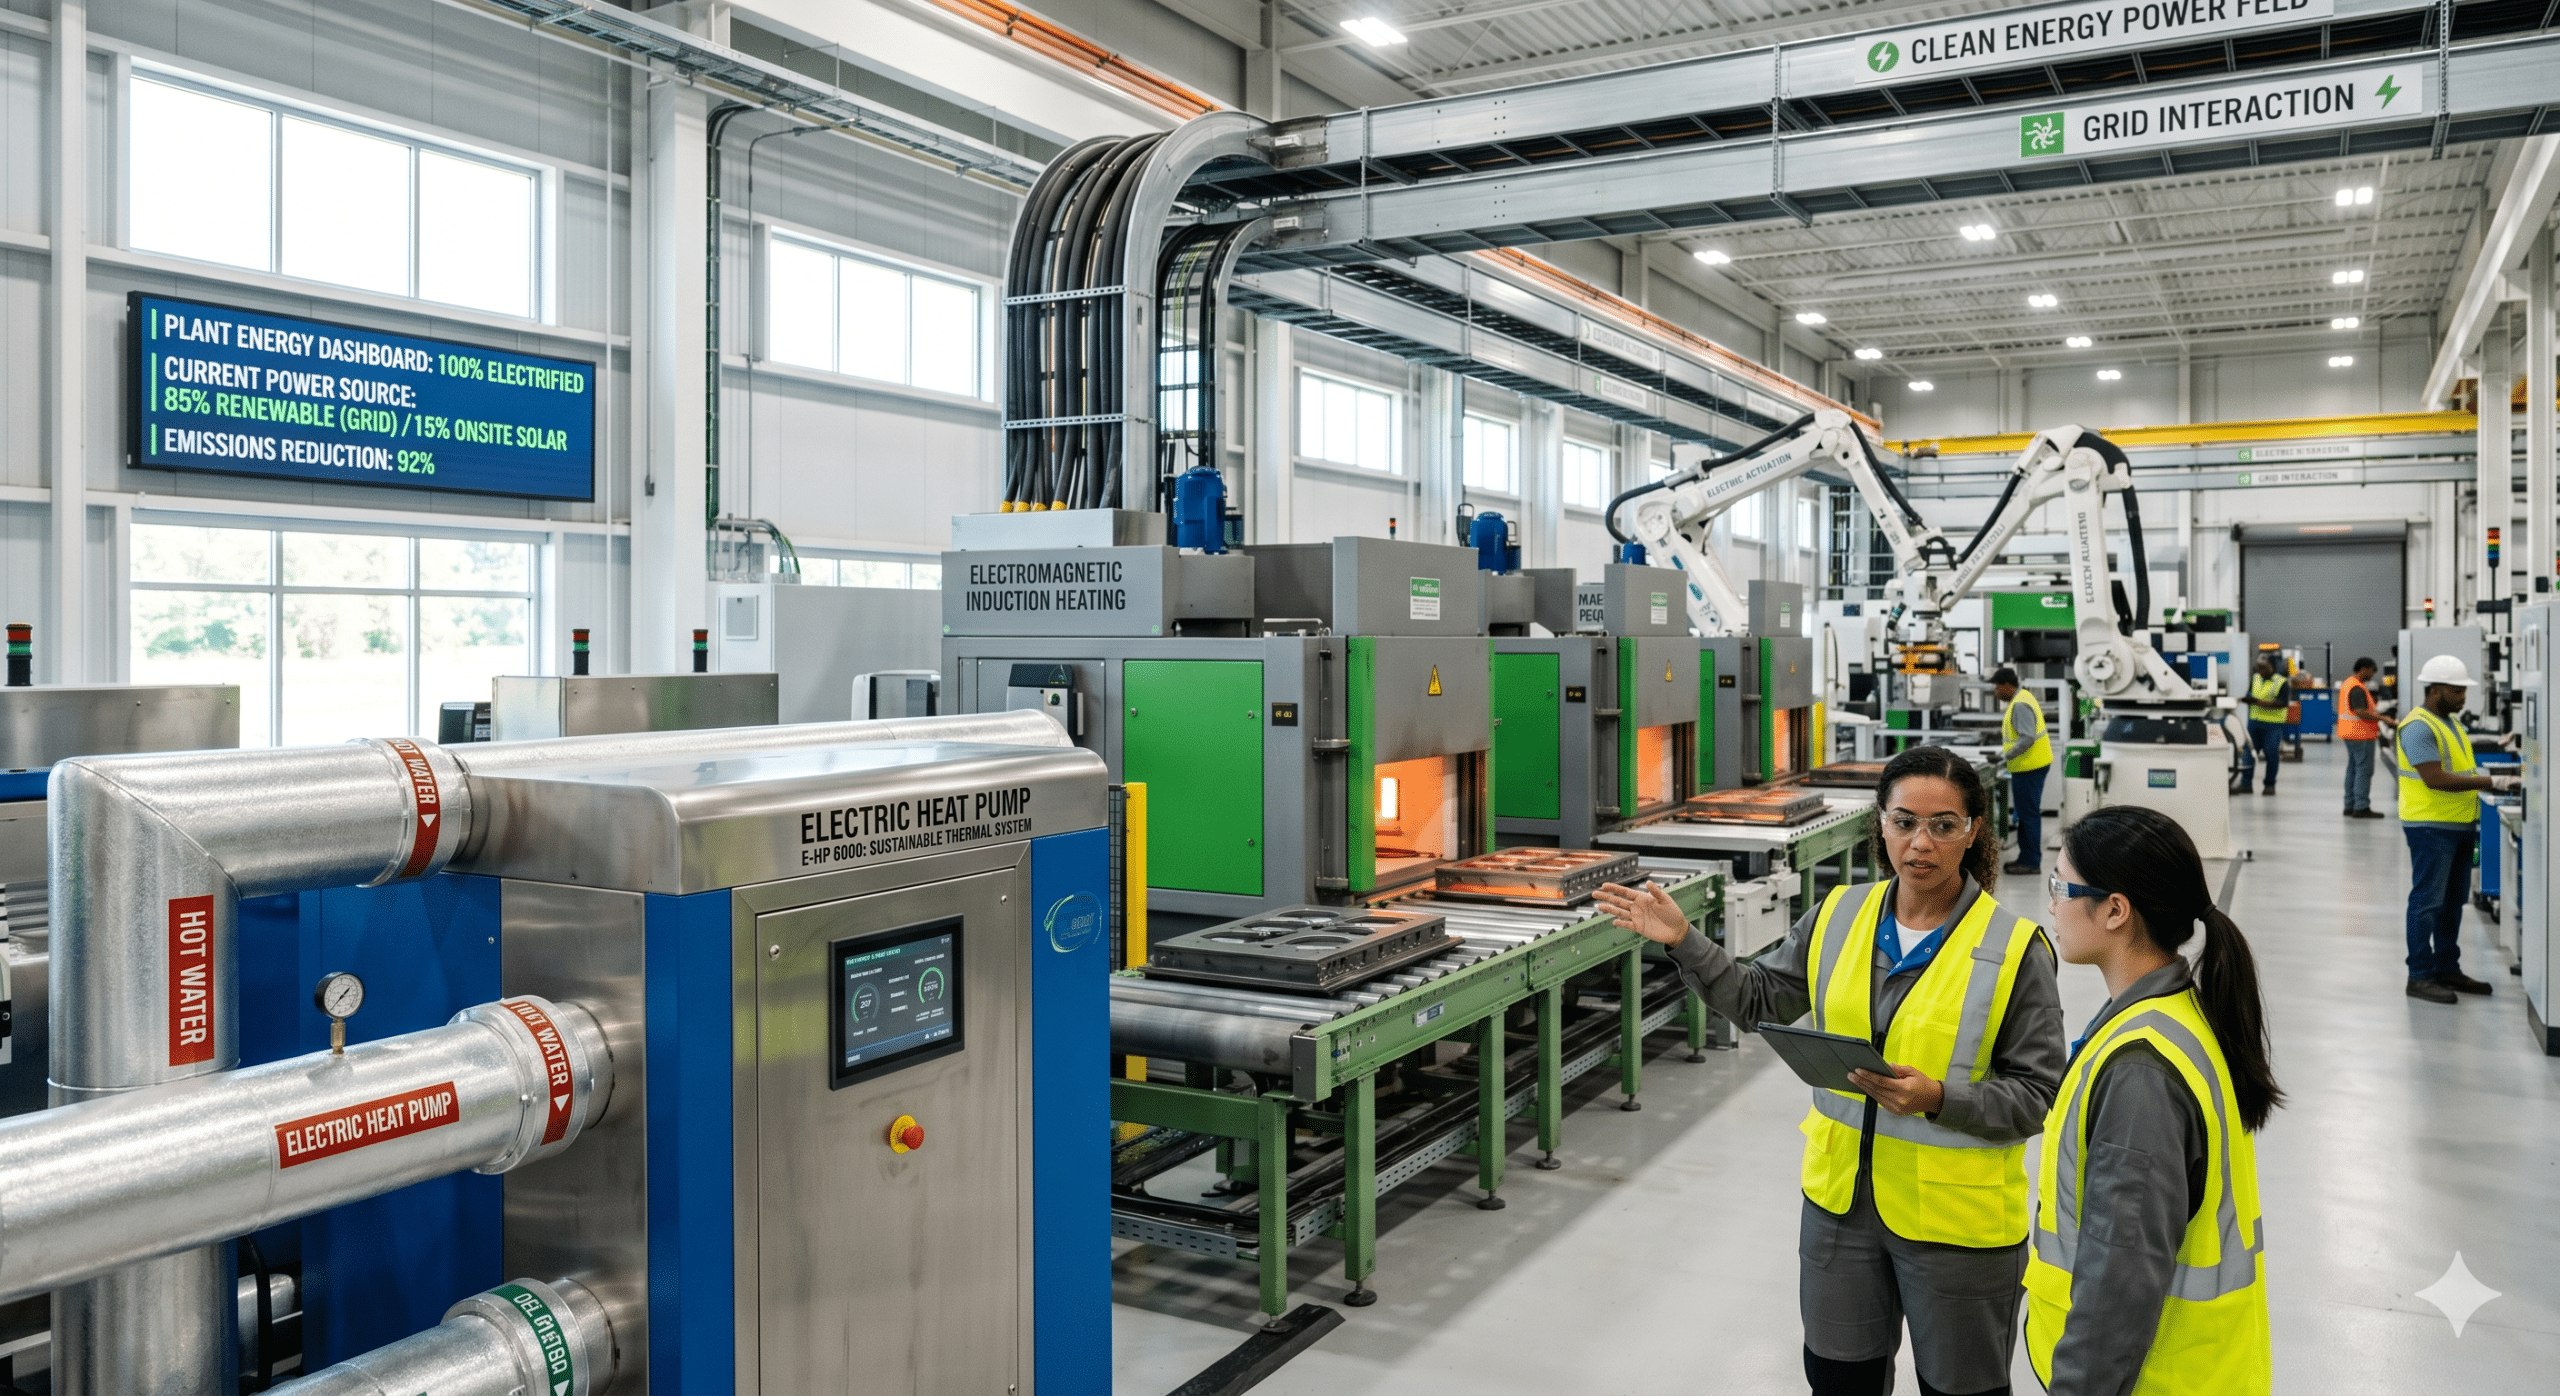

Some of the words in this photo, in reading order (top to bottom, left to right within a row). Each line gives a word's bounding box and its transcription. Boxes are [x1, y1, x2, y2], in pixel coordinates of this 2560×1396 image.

[1911, 28, 1995, 64] CLEAN
[2005, 10, 2114, 51] ENERGY
[2123, 0, 2226, 33] POWER
[2084, 109, 2148, 142] GRID
[2159, 83, 2354, 133] INTERACTION
[164, 314, 232, 346] PLANT
[237, 324, 314, 357] ENERGY
[318, 336, 433, 374] DASHBOARD:
[438, 353, 484, 380] 100%
[487, 361, 585, 394] ELECTRIFIED
[164, 356, 261, 390] CURRENT
[266, 369, 335, 399] POWER
[339, 377, 416, 408] SOURCE:
[164, 386, 211, 414] 85%
[216, 392, 335, 428] RENEWABLE
[340, 405, 397, 438] (GRID)
[454, 419, 513, 446] ONSITE
[516, 426, 568, 451] SOLAR
[164, 428, 277, 461] EMISSIONS
[281, 439, 393, 471] REDUCTION:
[397, 450, 435, 475] 92%
[966, 590, 1050, 611] INDUCTION
[1056, 589, 1126, 611] HEATING
[970, 561, 1122, 585] ELECTROMAGNETIC
[406, 758, 437, 804] WATER
[801, 801, 910, 845] ELECTRIC
[917, 794, 969, 828] HEAT
[975, 787, 1031, 820] PUMP
[802, 847, 831, 866] E-HP
[833, 844, 867, 862] 6000:
[870, 830, 943, 856] SUSTAINABLE
[945, 826, 992, 844] THERMAL
[995, 817, 1032, 837] SYSTEM
[180, 910, 206, 957] HOT
[180, 963, 207, 1046] WATER
[537, 1027, 569, 1087] WATER
[285, 1113, 364, 1157] ELECTRIC
[365, 1102, 404, 1136] HEAT
[408, 1091, 452, 1124] PUMP
